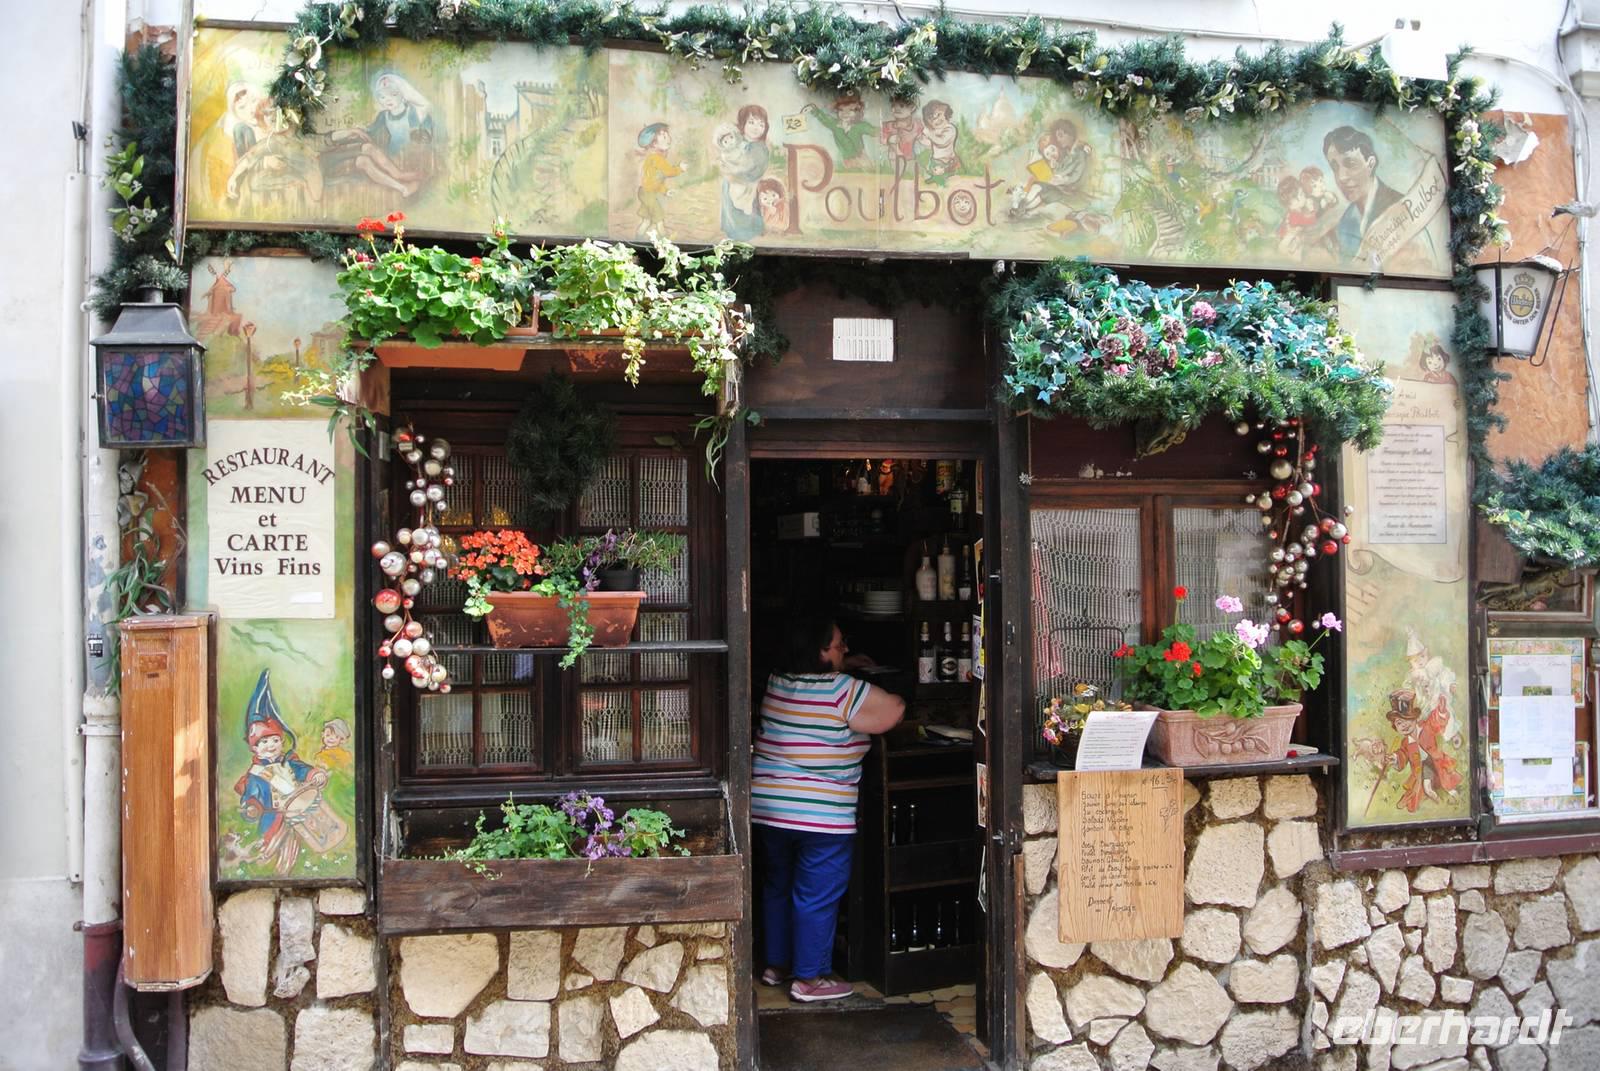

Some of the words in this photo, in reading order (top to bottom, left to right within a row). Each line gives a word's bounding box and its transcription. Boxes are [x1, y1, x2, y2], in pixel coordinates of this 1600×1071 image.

[782, 143, 1006, 236] Poulbot
[201, 447, 336, 487] RESTAURANT
[229, 486, 307, 504] MENU
[257, 512, 278, 528] et
[226, 533, 309, 552] CARTE
[214, 557, 264, 576] Vins
[277, 557, 322, 576] Fins
